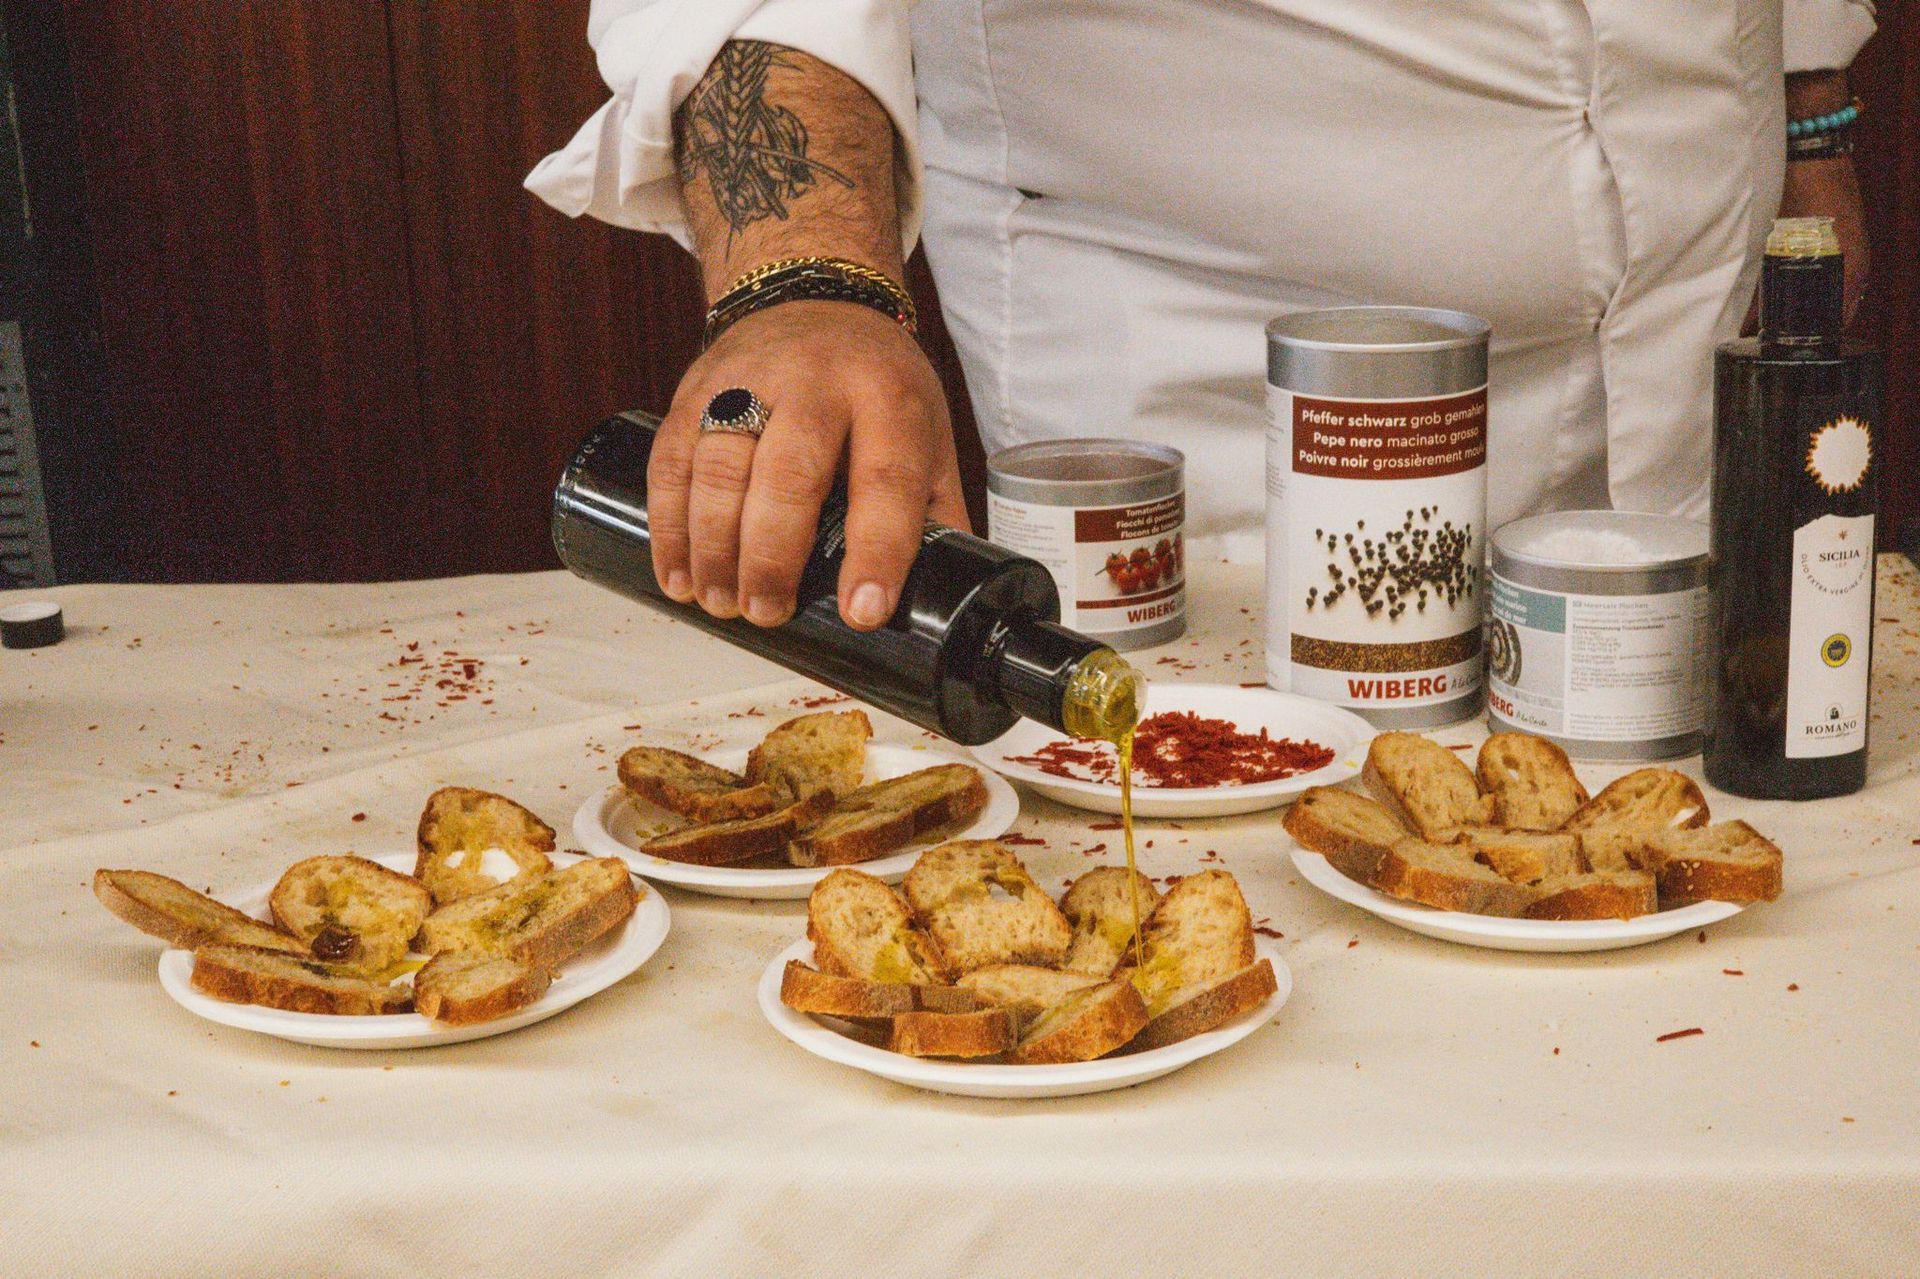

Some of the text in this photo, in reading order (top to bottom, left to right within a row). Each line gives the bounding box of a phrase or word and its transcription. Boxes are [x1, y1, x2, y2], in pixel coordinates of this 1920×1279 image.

[1302, 409, 1344, 426] Pfeffer
[1348, 413, 1407, 427] schwarz
[1410, 411, 1442, 429] grob
[1313, 426, 1479, 448] Pepe nero macinato grosso
[1299, 450, 1337, 466] Poivre
[1341, 453, 1369, 468] noir
[1373, 451, 1462, 471] grossièrement
[1116, 517, 1145, 529] Fiocchi
[1120, 529, 1150, 539] Flocons
[1818, 548, 1861, 563] SICILIA
[1127, 600, 1176, 624] WIBERG
[1347, 674, 1447, 699] WIBERG
[1805, 719, 1857, 735] ROMANO
